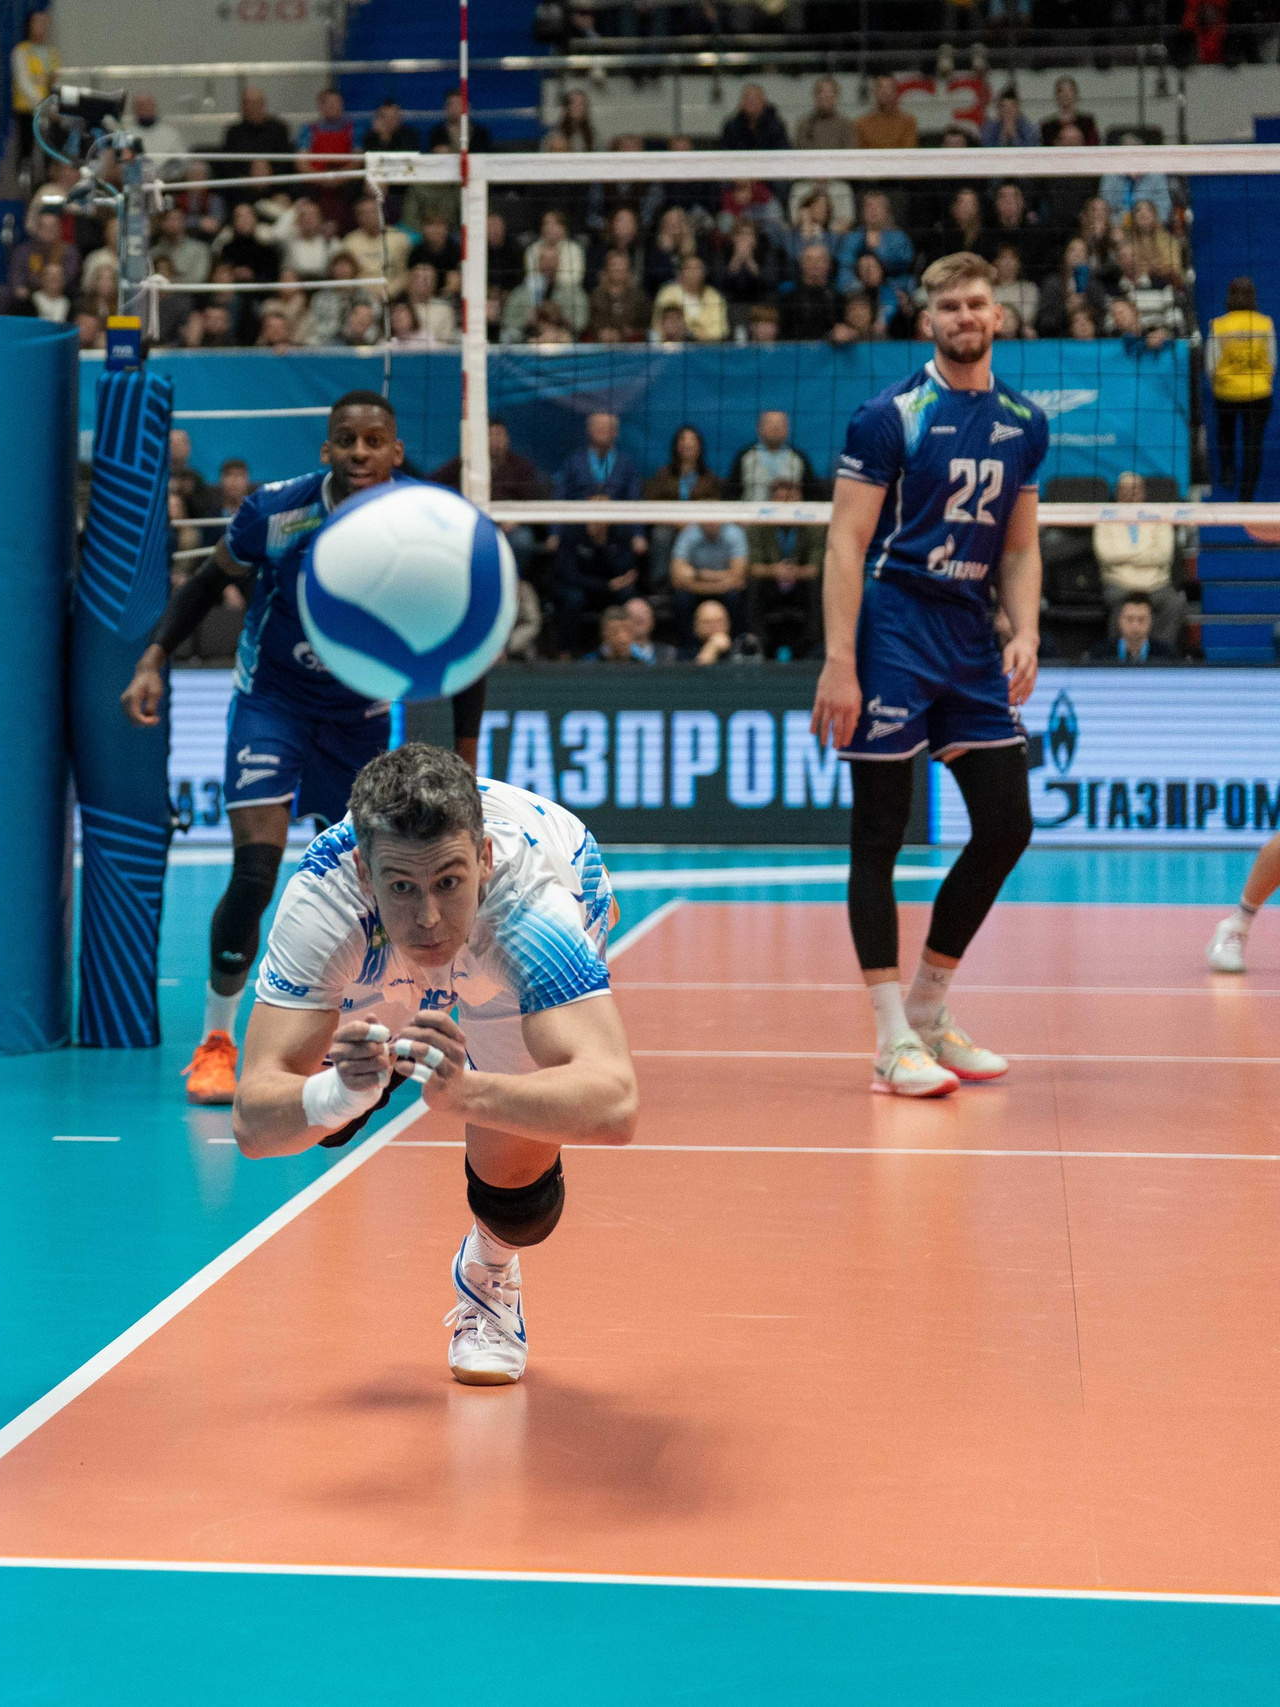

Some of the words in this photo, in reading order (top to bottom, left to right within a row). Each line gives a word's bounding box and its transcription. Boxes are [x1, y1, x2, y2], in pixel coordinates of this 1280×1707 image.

[944, 457, 1005, 526] 22
[476, 709, 854, 809] ГАЗПРОМ
[1086, 778, 1280, 830] ГАЗПРОМ
